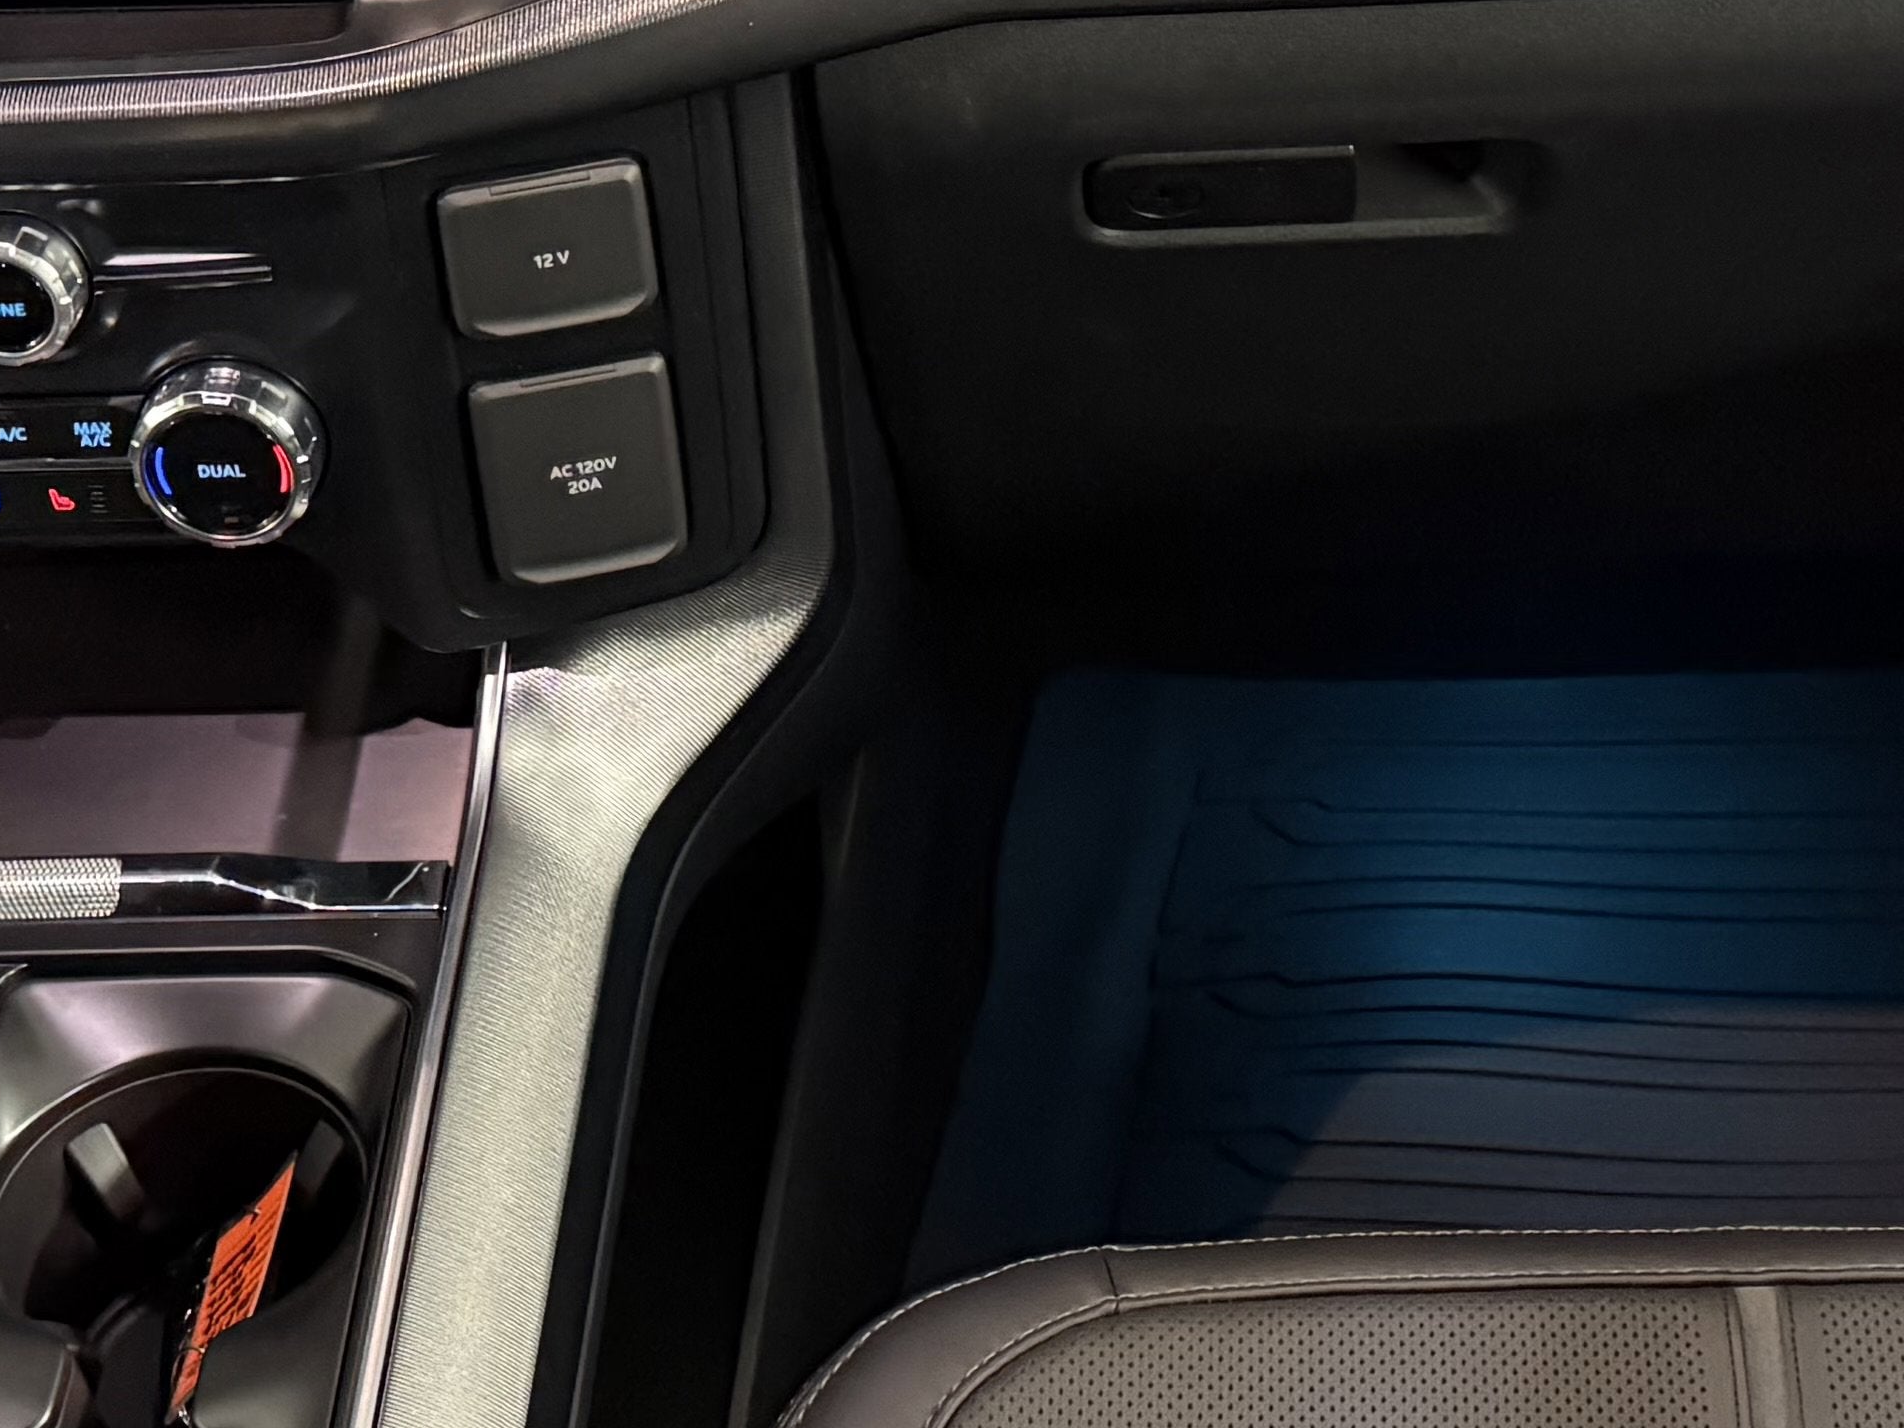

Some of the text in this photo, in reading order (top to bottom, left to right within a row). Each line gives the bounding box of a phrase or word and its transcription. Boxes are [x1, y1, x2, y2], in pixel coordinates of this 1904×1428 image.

[533, 249, 571, 269] 12 V
[73, 421, 112, 438] MAX
[80, 433, 112, 449] A/C
[197, 463, 246, 480] DUAL
[549, 455, 618, 482] AC 120V
[567, 476, 604, 496] 20A
